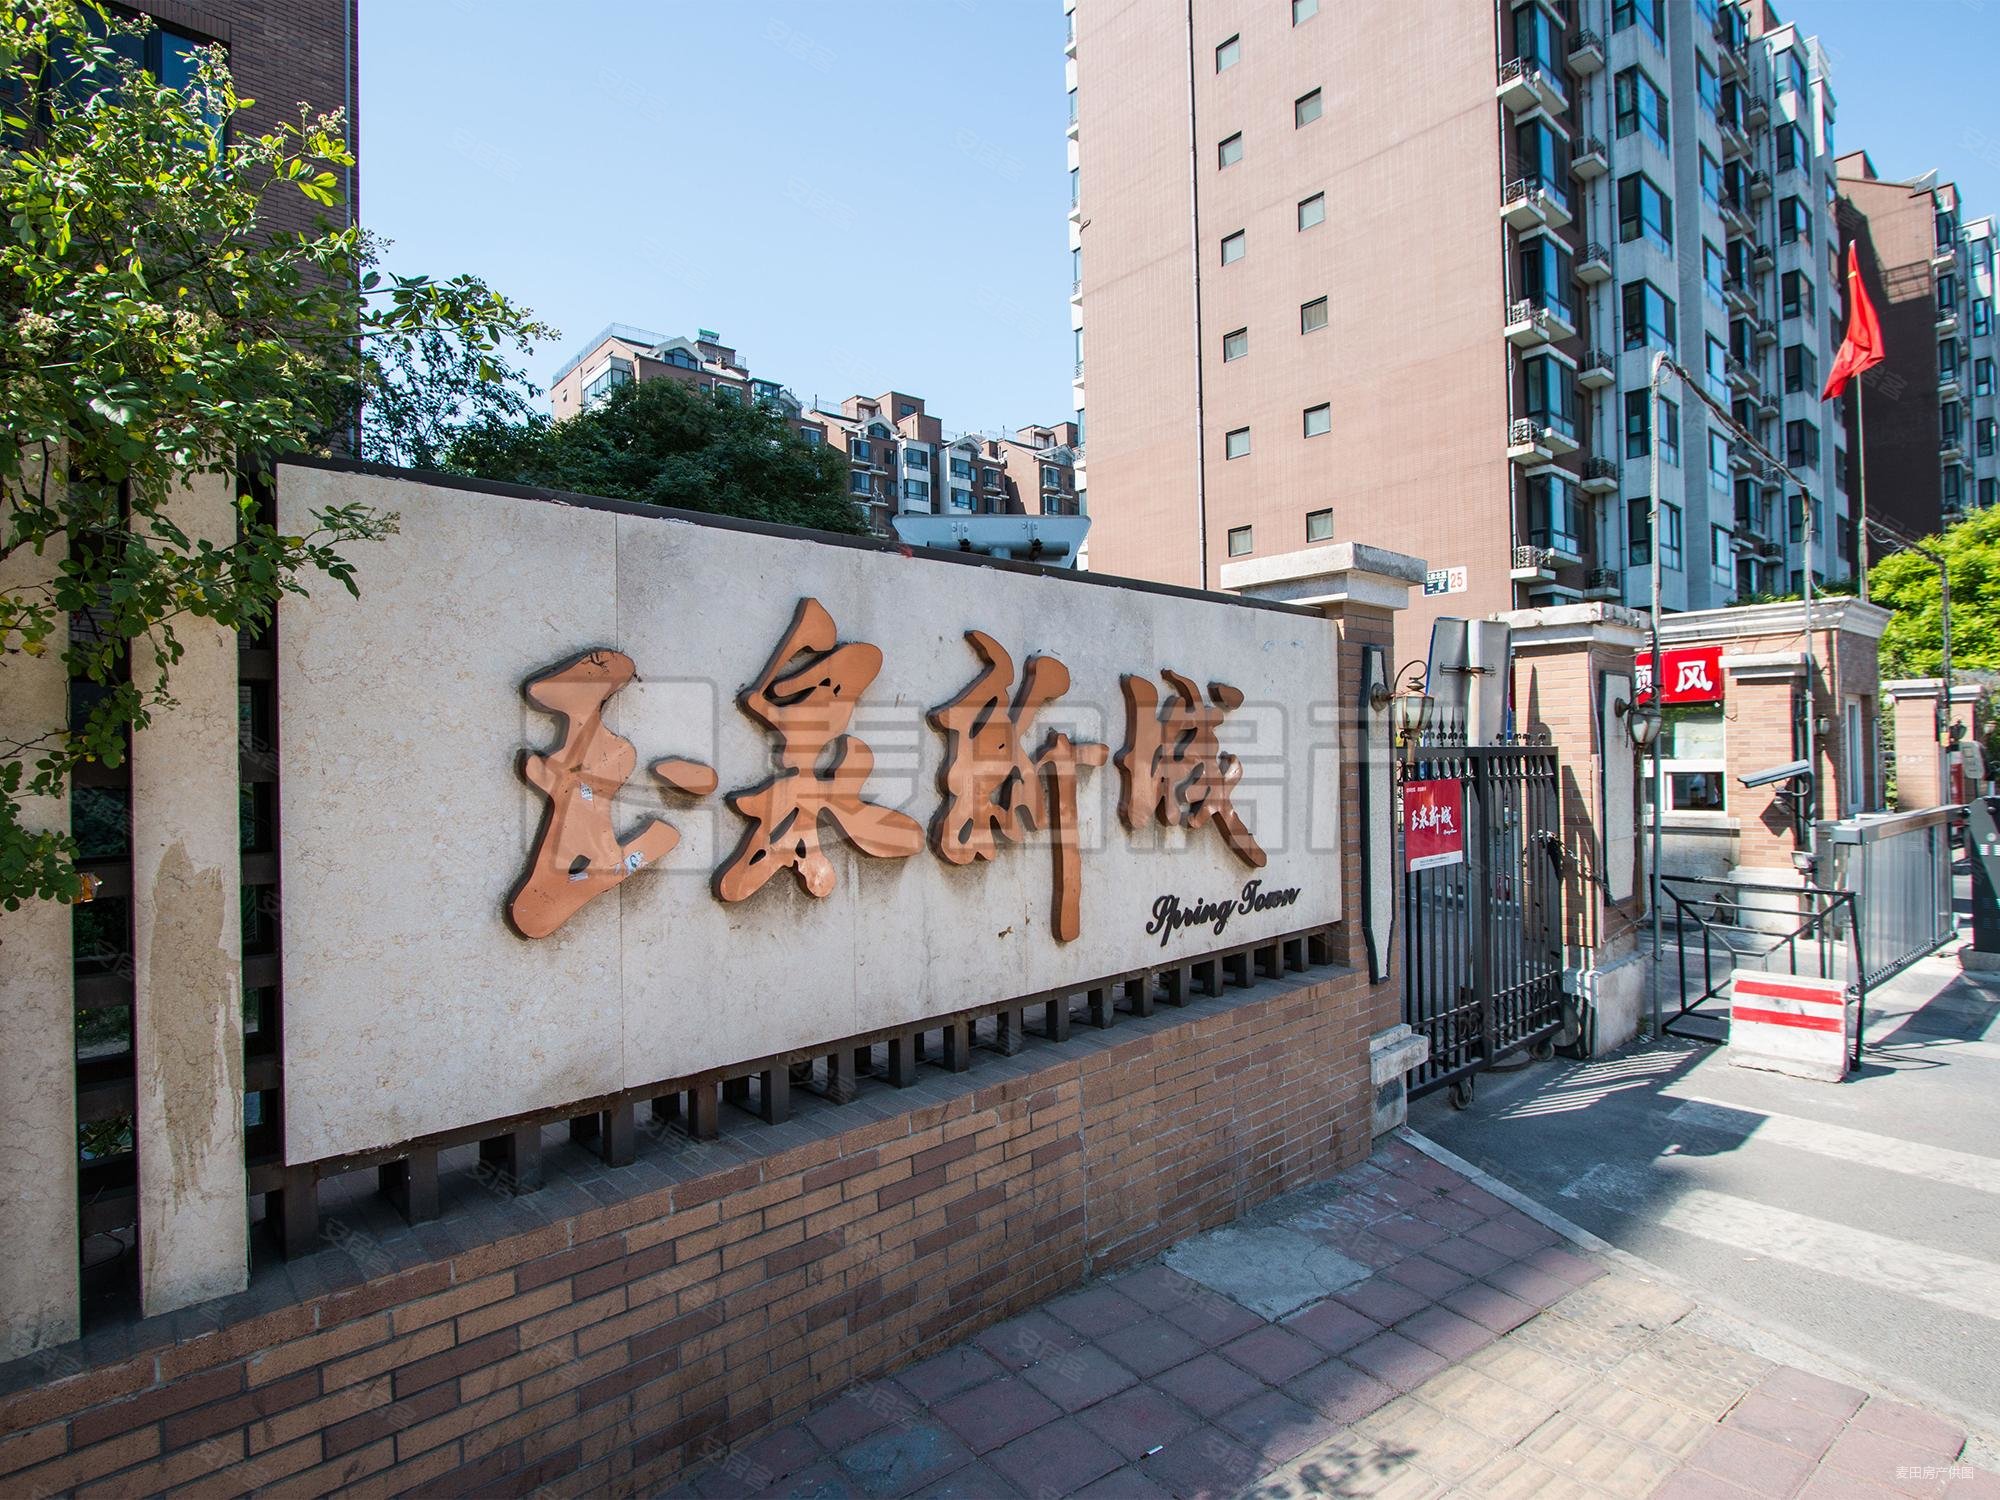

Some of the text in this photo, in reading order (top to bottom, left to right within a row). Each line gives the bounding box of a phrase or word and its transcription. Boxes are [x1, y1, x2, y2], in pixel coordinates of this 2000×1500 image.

[1450, 572, 1463, 588] 25
[507, 597, 1267, 942] 玉泉新城
[1146, 879, 1302, 947] Spring Town
